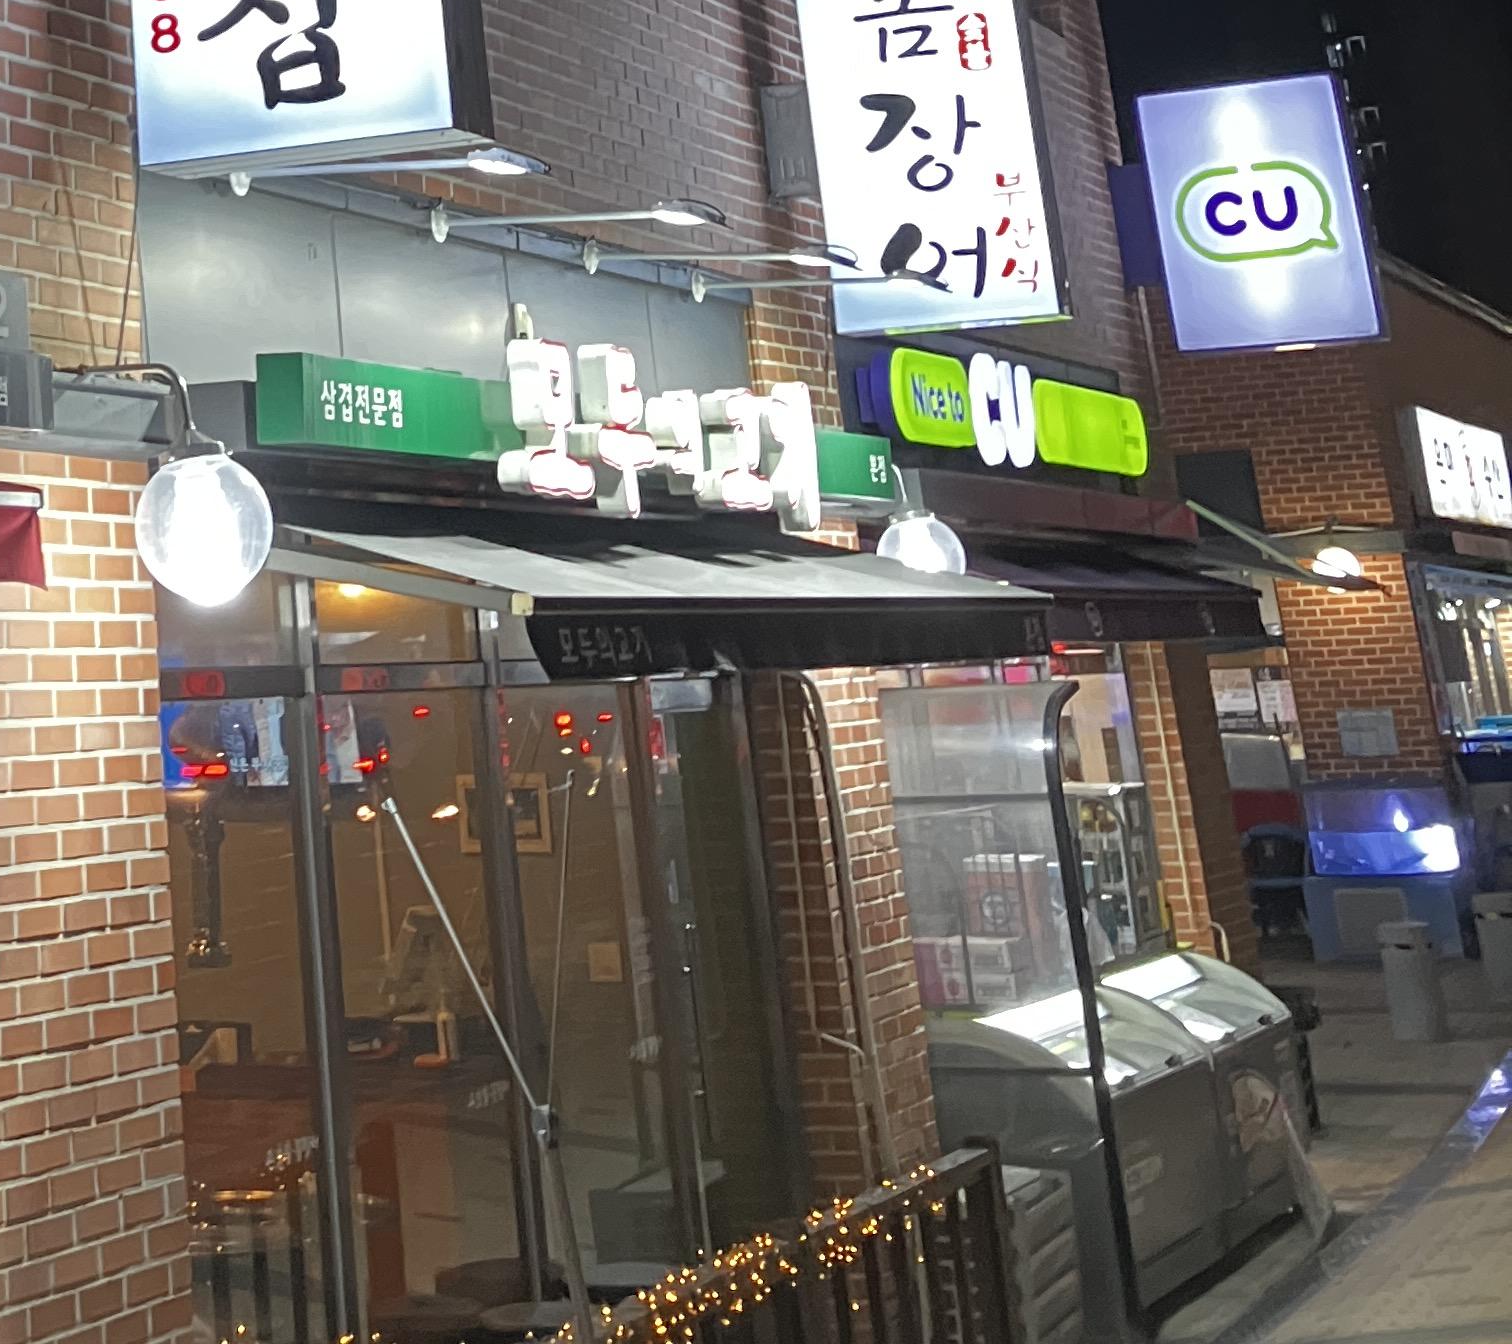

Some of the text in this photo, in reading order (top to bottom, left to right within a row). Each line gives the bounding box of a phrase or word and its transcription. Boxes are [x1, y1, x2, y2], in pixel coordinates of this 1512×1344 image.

[993, 172, 1039, 293] 부산식
[1205, 186, 1299, 236] CU
[320, 380, 403, 428] 삼겹전문점
